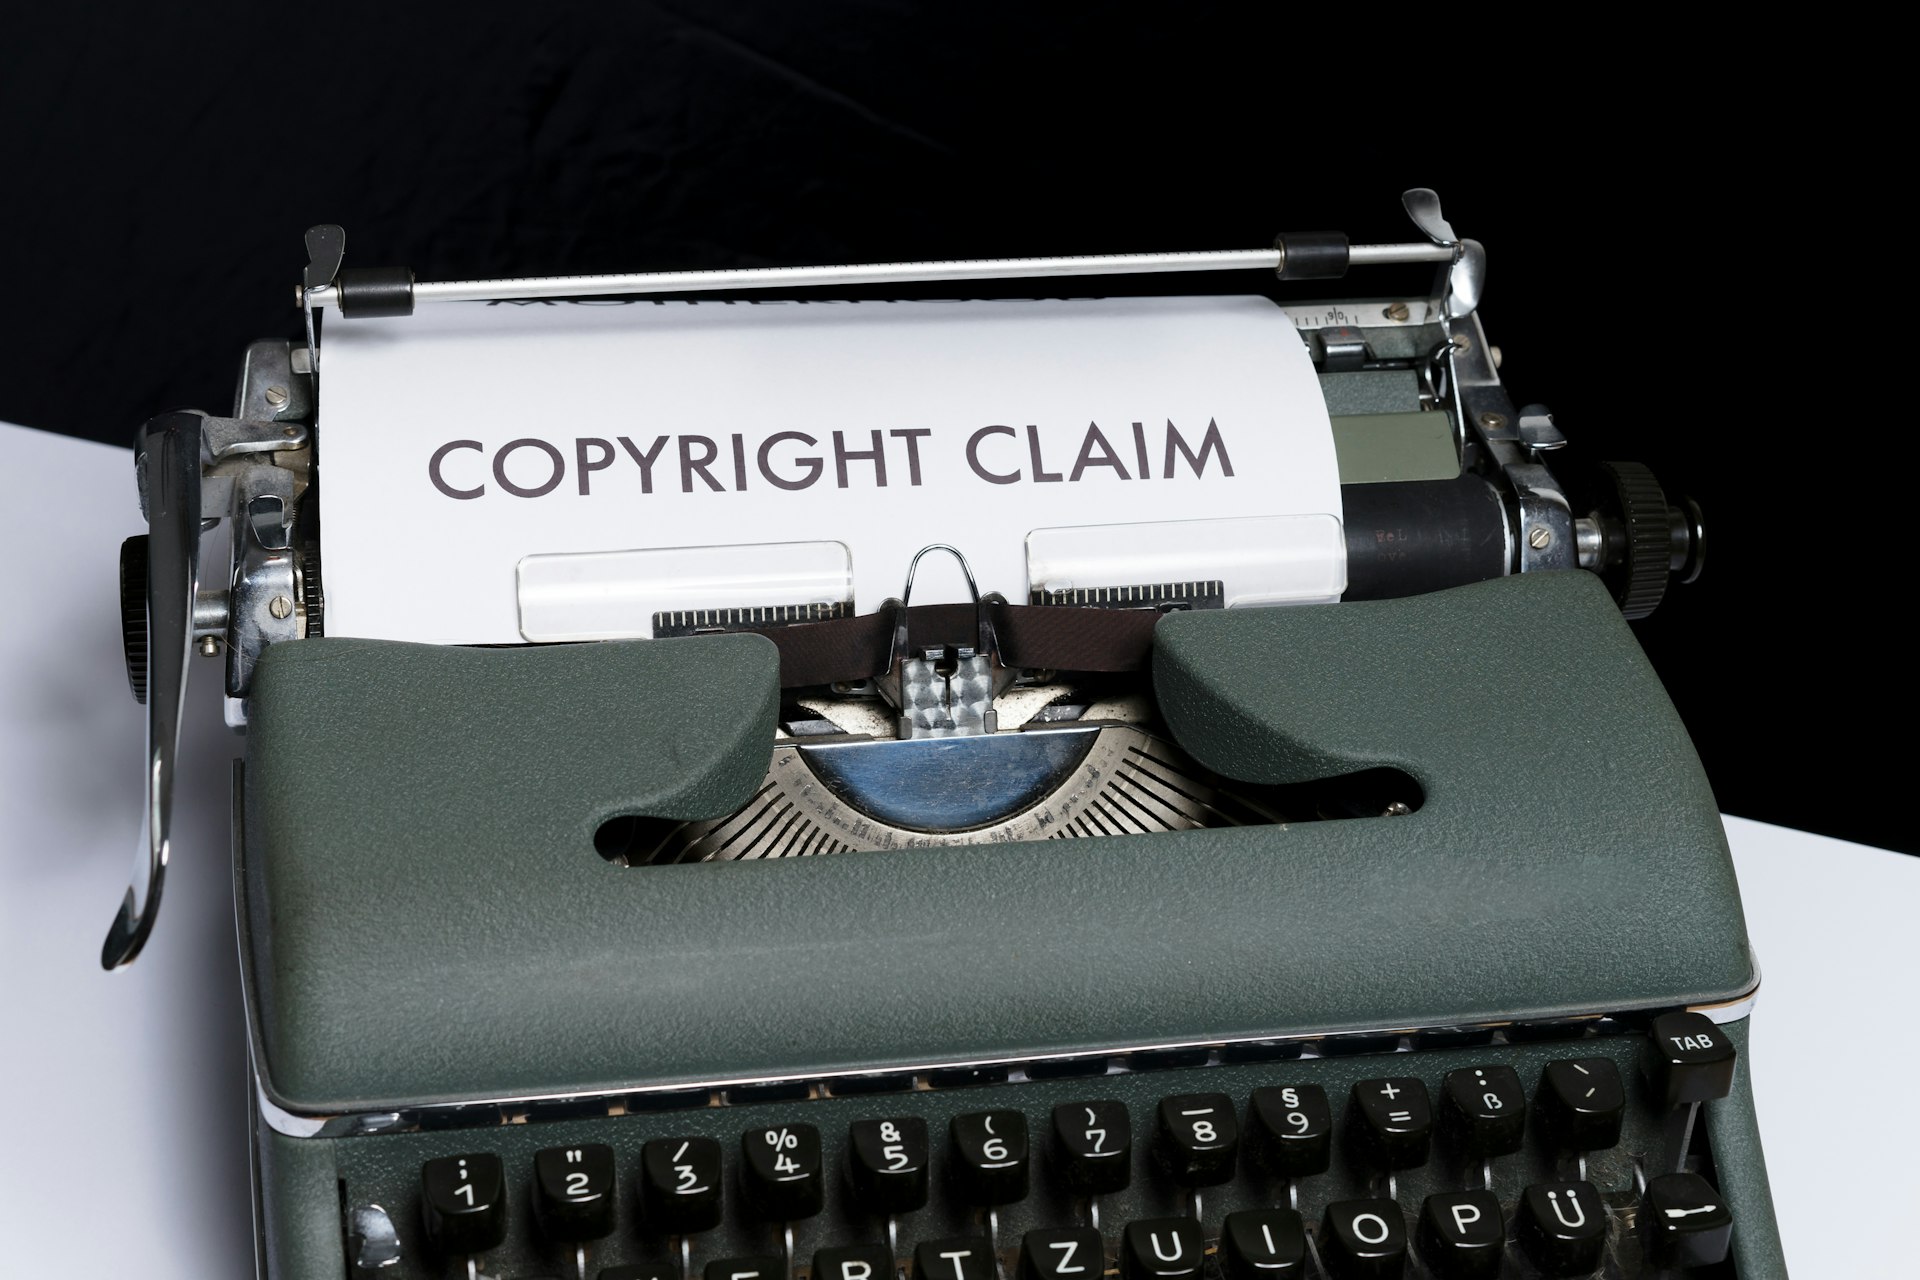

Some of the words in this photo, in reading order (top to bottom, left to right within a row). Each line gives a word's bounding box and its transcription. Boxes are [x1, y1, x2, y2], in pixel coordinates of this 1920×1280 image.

[428, 428, 932, 500] COPYRIGHT
[965, 416, 1235, 485] CLAIM
[1670, 1033, 1714, 1051] TAB
[879, 1121, 902, 1143] &
[1192, 1120, 1217, 1142] 8
[1286, 1111, 1309, 1134] 9
[765, 1128, 798, 1152] %
[983, 1138, 1008, 1160] 6
[1085, 1128, 1106, 1153] 7
[774, 1153, 801, 1174] 4
[883, 1145, 909, 1171] 5
[565, 1172, 589, 1195] 2
[674, 1165, 698, 1190] 3
[454, 1183, 474, 1206] 1
[1451, 1204, 1481, 1234] P
[1547, 1189, 1585, 1228] Ü
[1261, 1224, 1276, 1255] I
[1352, 1213, 1389, 1244] O
[1049, 1241, 1085, 1274] Z
[1150, 1230, 1183, 1262] U
[939, 1250, 972, 1280] T
